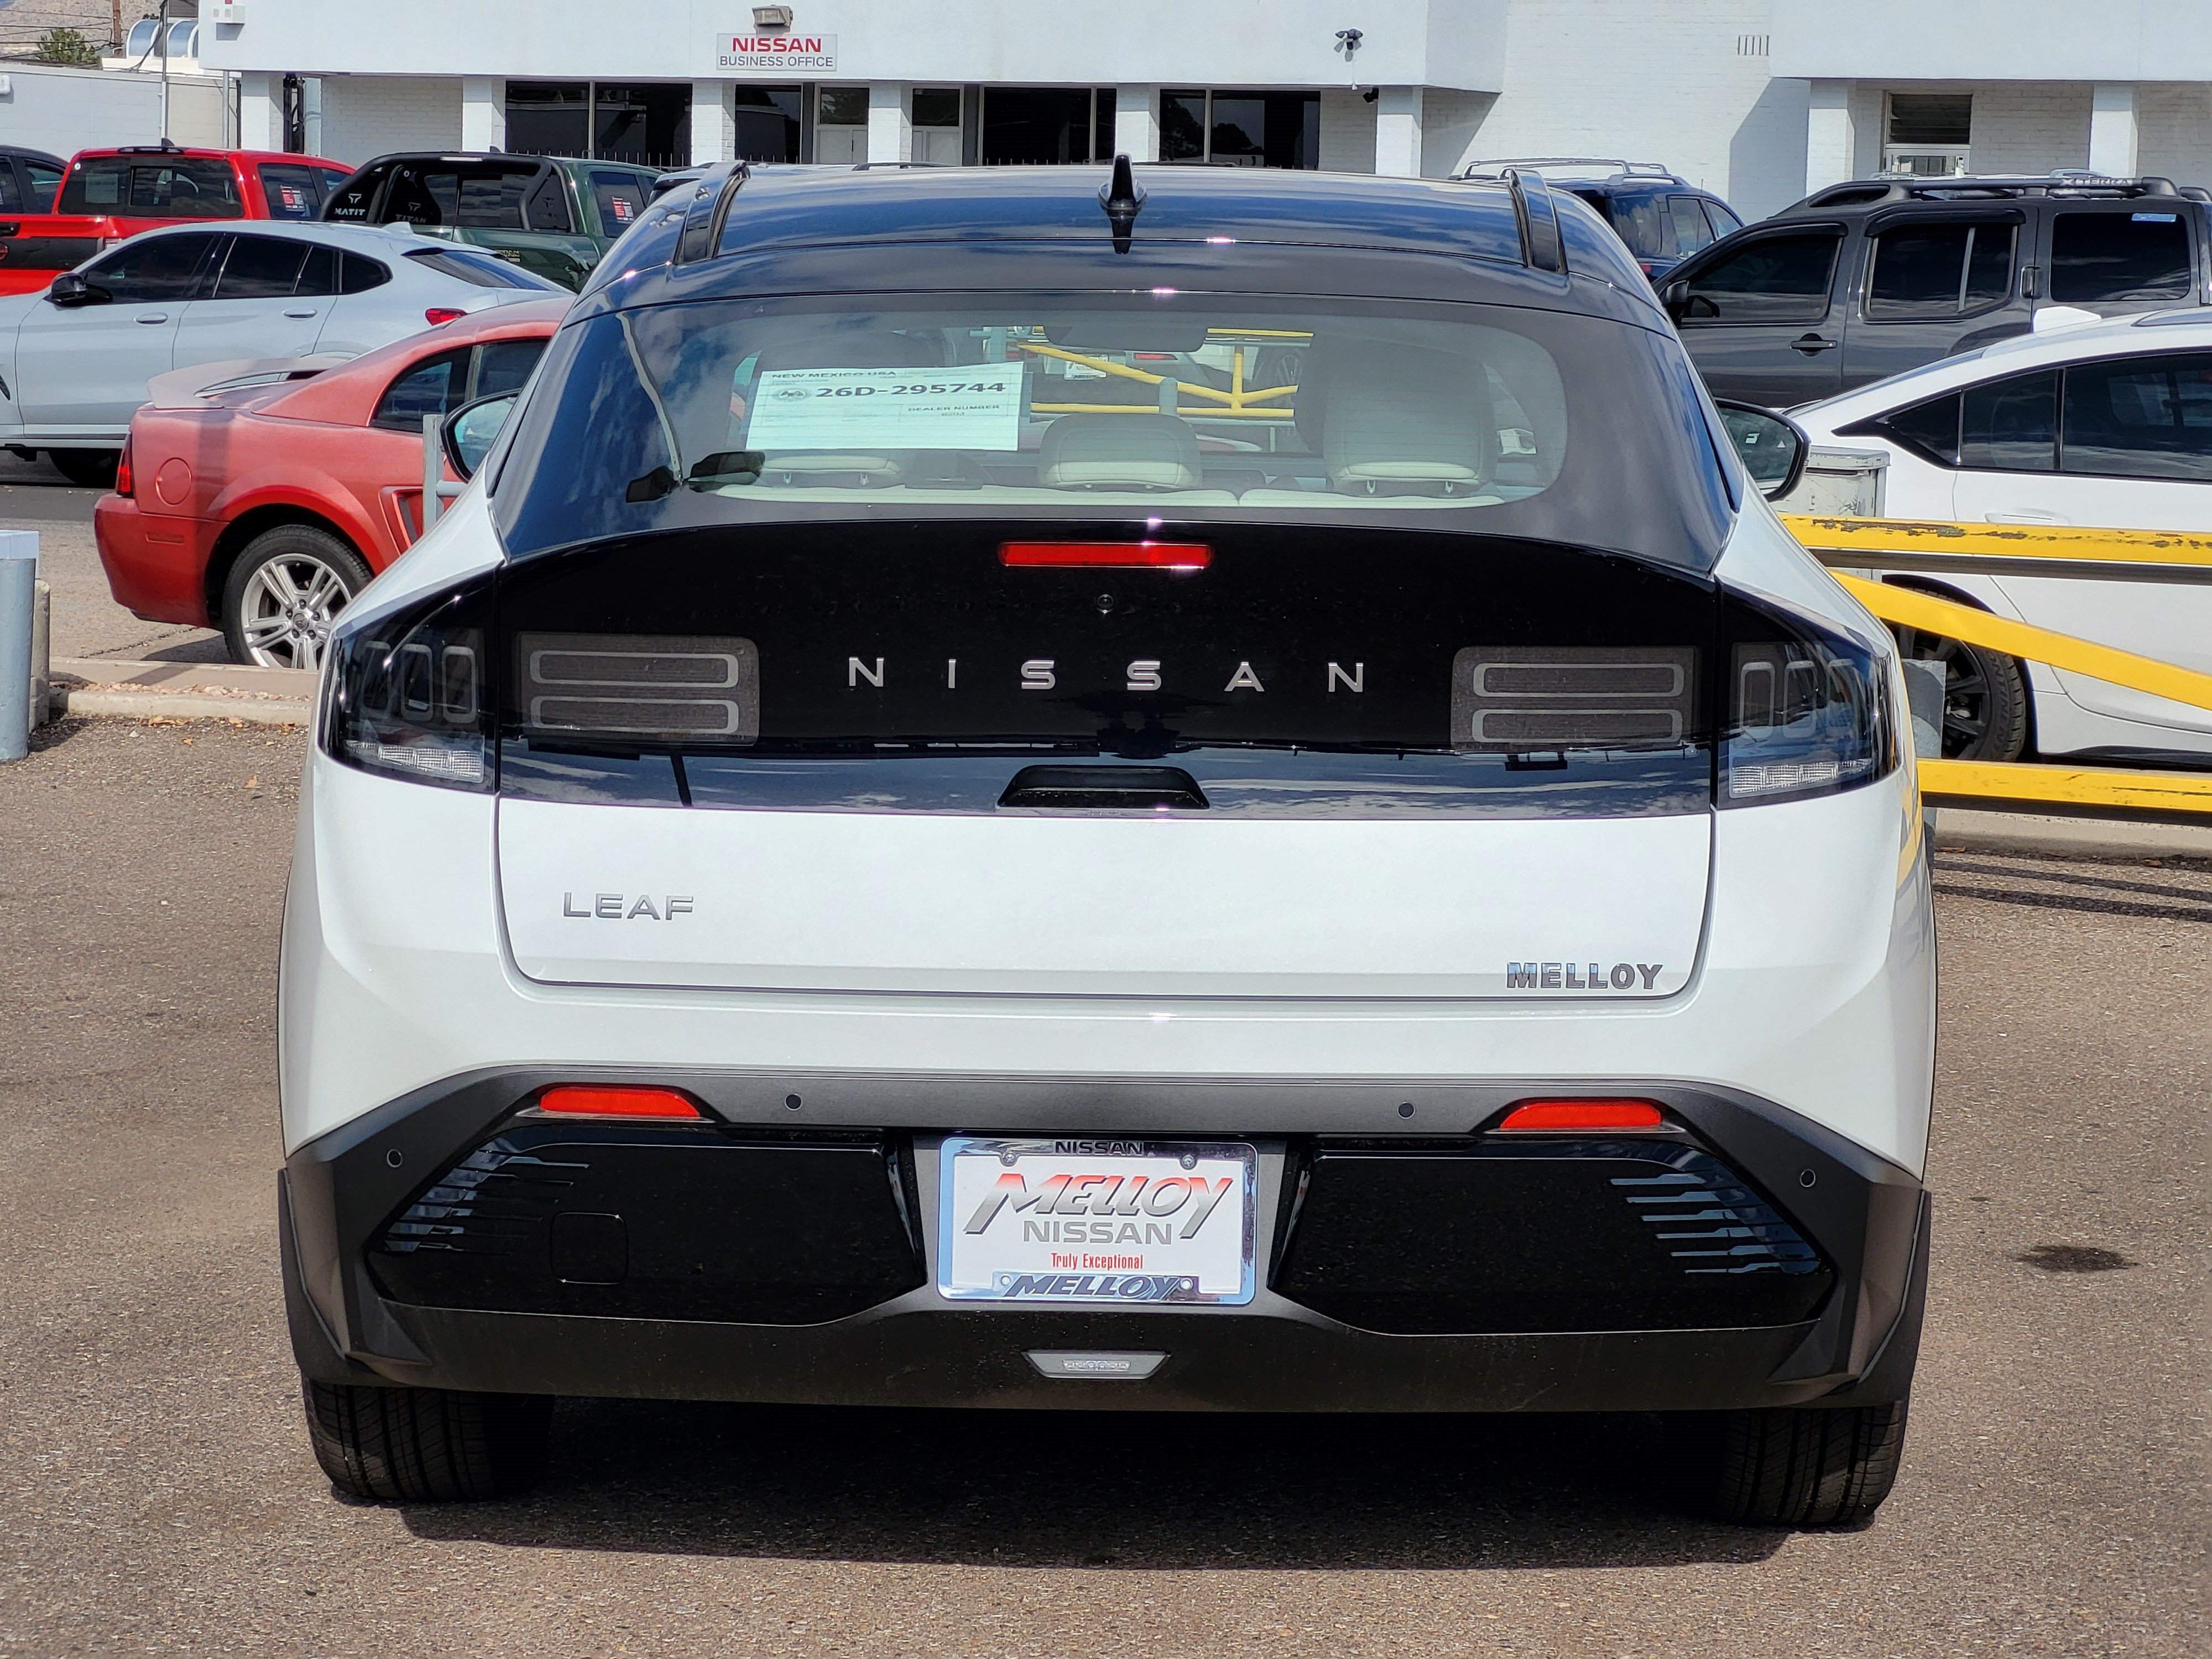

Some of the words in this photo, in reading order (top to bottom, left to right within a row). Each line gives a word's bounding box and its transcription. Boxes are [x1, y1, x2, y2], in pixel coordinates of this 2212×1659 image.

[732, 38, 821, 53] NISSAN
[719, 56, 784, 66] BUSINESS
[787, 56, 833, 67] OFFICE
[395, 213, 427, 223] TITAN
[815, 382, 1006, 398] 26D-295744
[848, 656, 1364, 692] NISSAN
[564, 891, 693, 921] LEAF
[1507, 962, 1663, 990] MELLOY
[1053, 1140, 1145, 1156] NISSAN
[963, 1172, 1234, 1240] MELLOY
[1023, 1220, 1172, 1245] NISSAN
[1051, 1252, 1078, 1271] Truly
[1083, 1253, 1144, 1271] Exceptional
[1004, 1275, 1182, 1300] MELLOY
